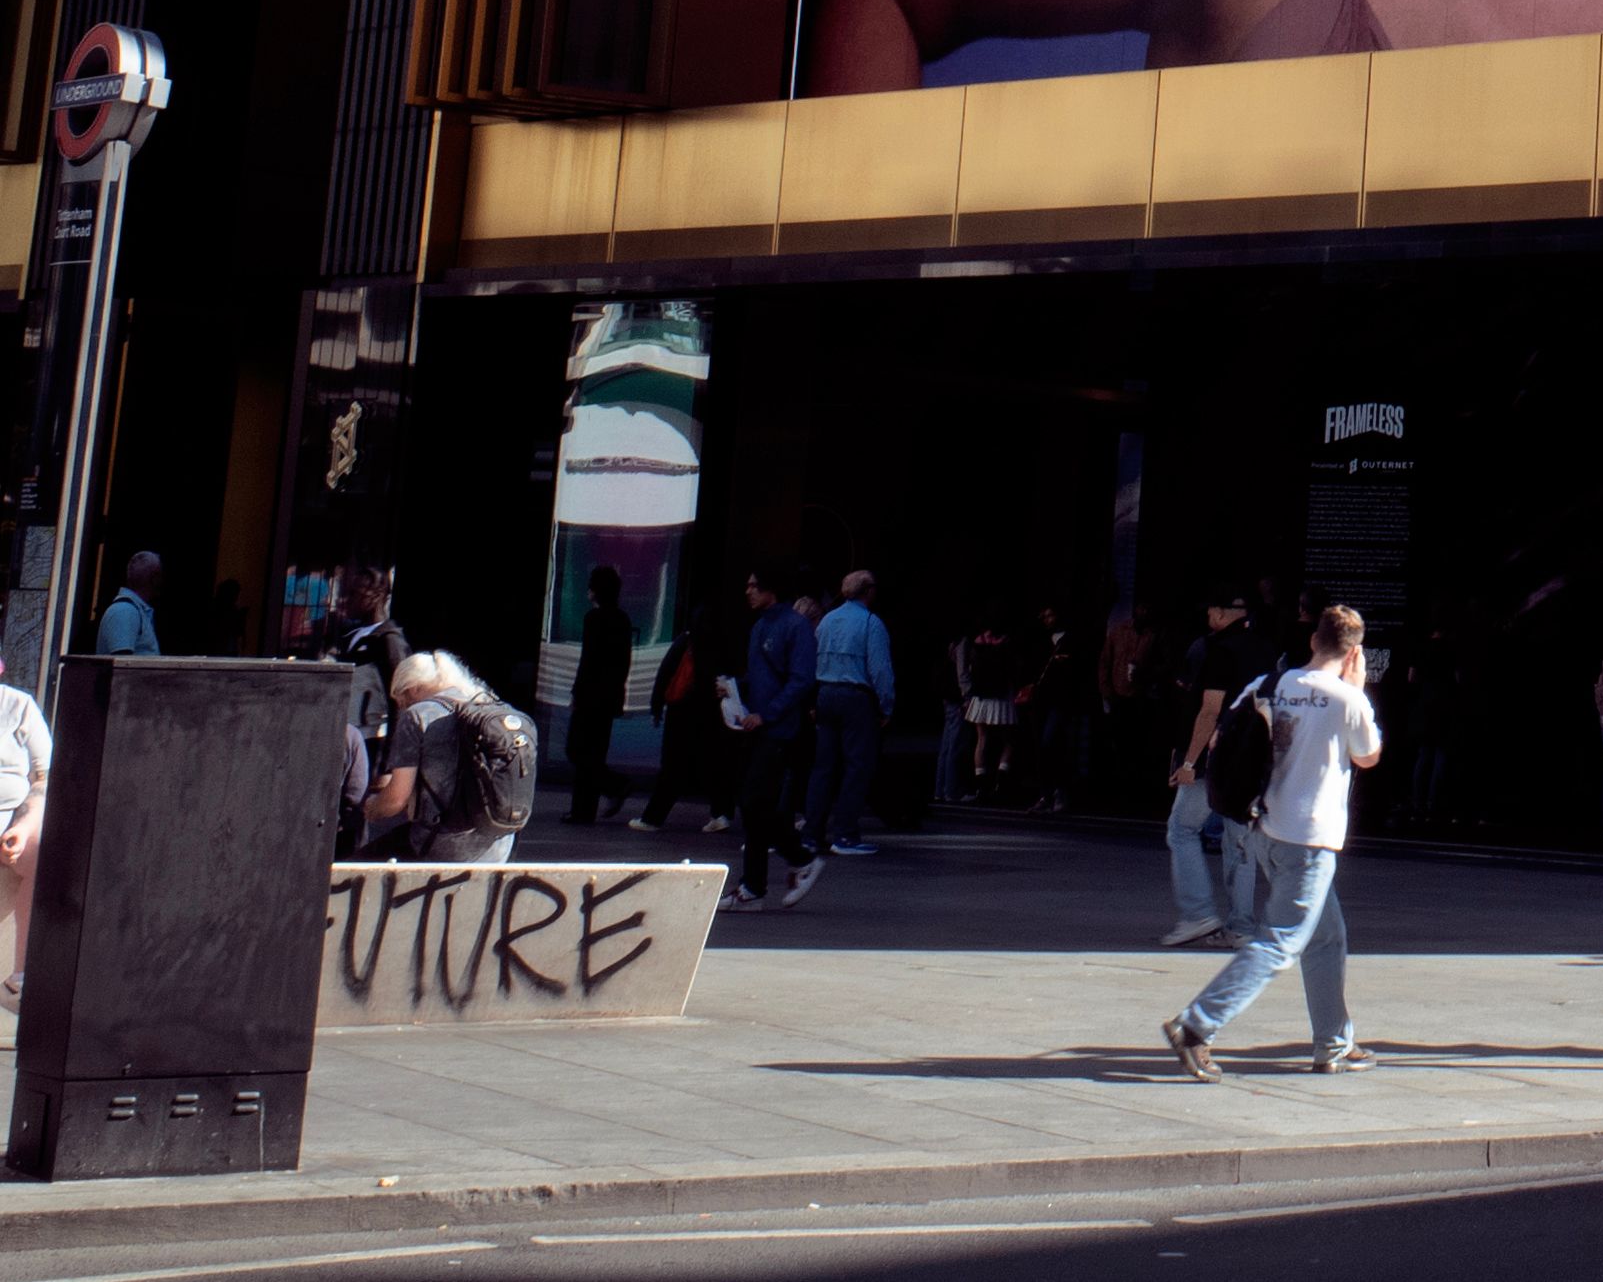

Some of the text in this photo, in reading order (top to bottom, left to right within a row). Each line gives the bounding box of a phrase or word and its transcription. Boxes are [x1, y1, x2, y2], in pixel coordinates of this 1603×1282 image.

[56, 79, 123, 104] UNDERGROUND
[1324, 402, 1405, 445] FRAMELESS
[1361, 460, 1415, 470] OUTERNET
